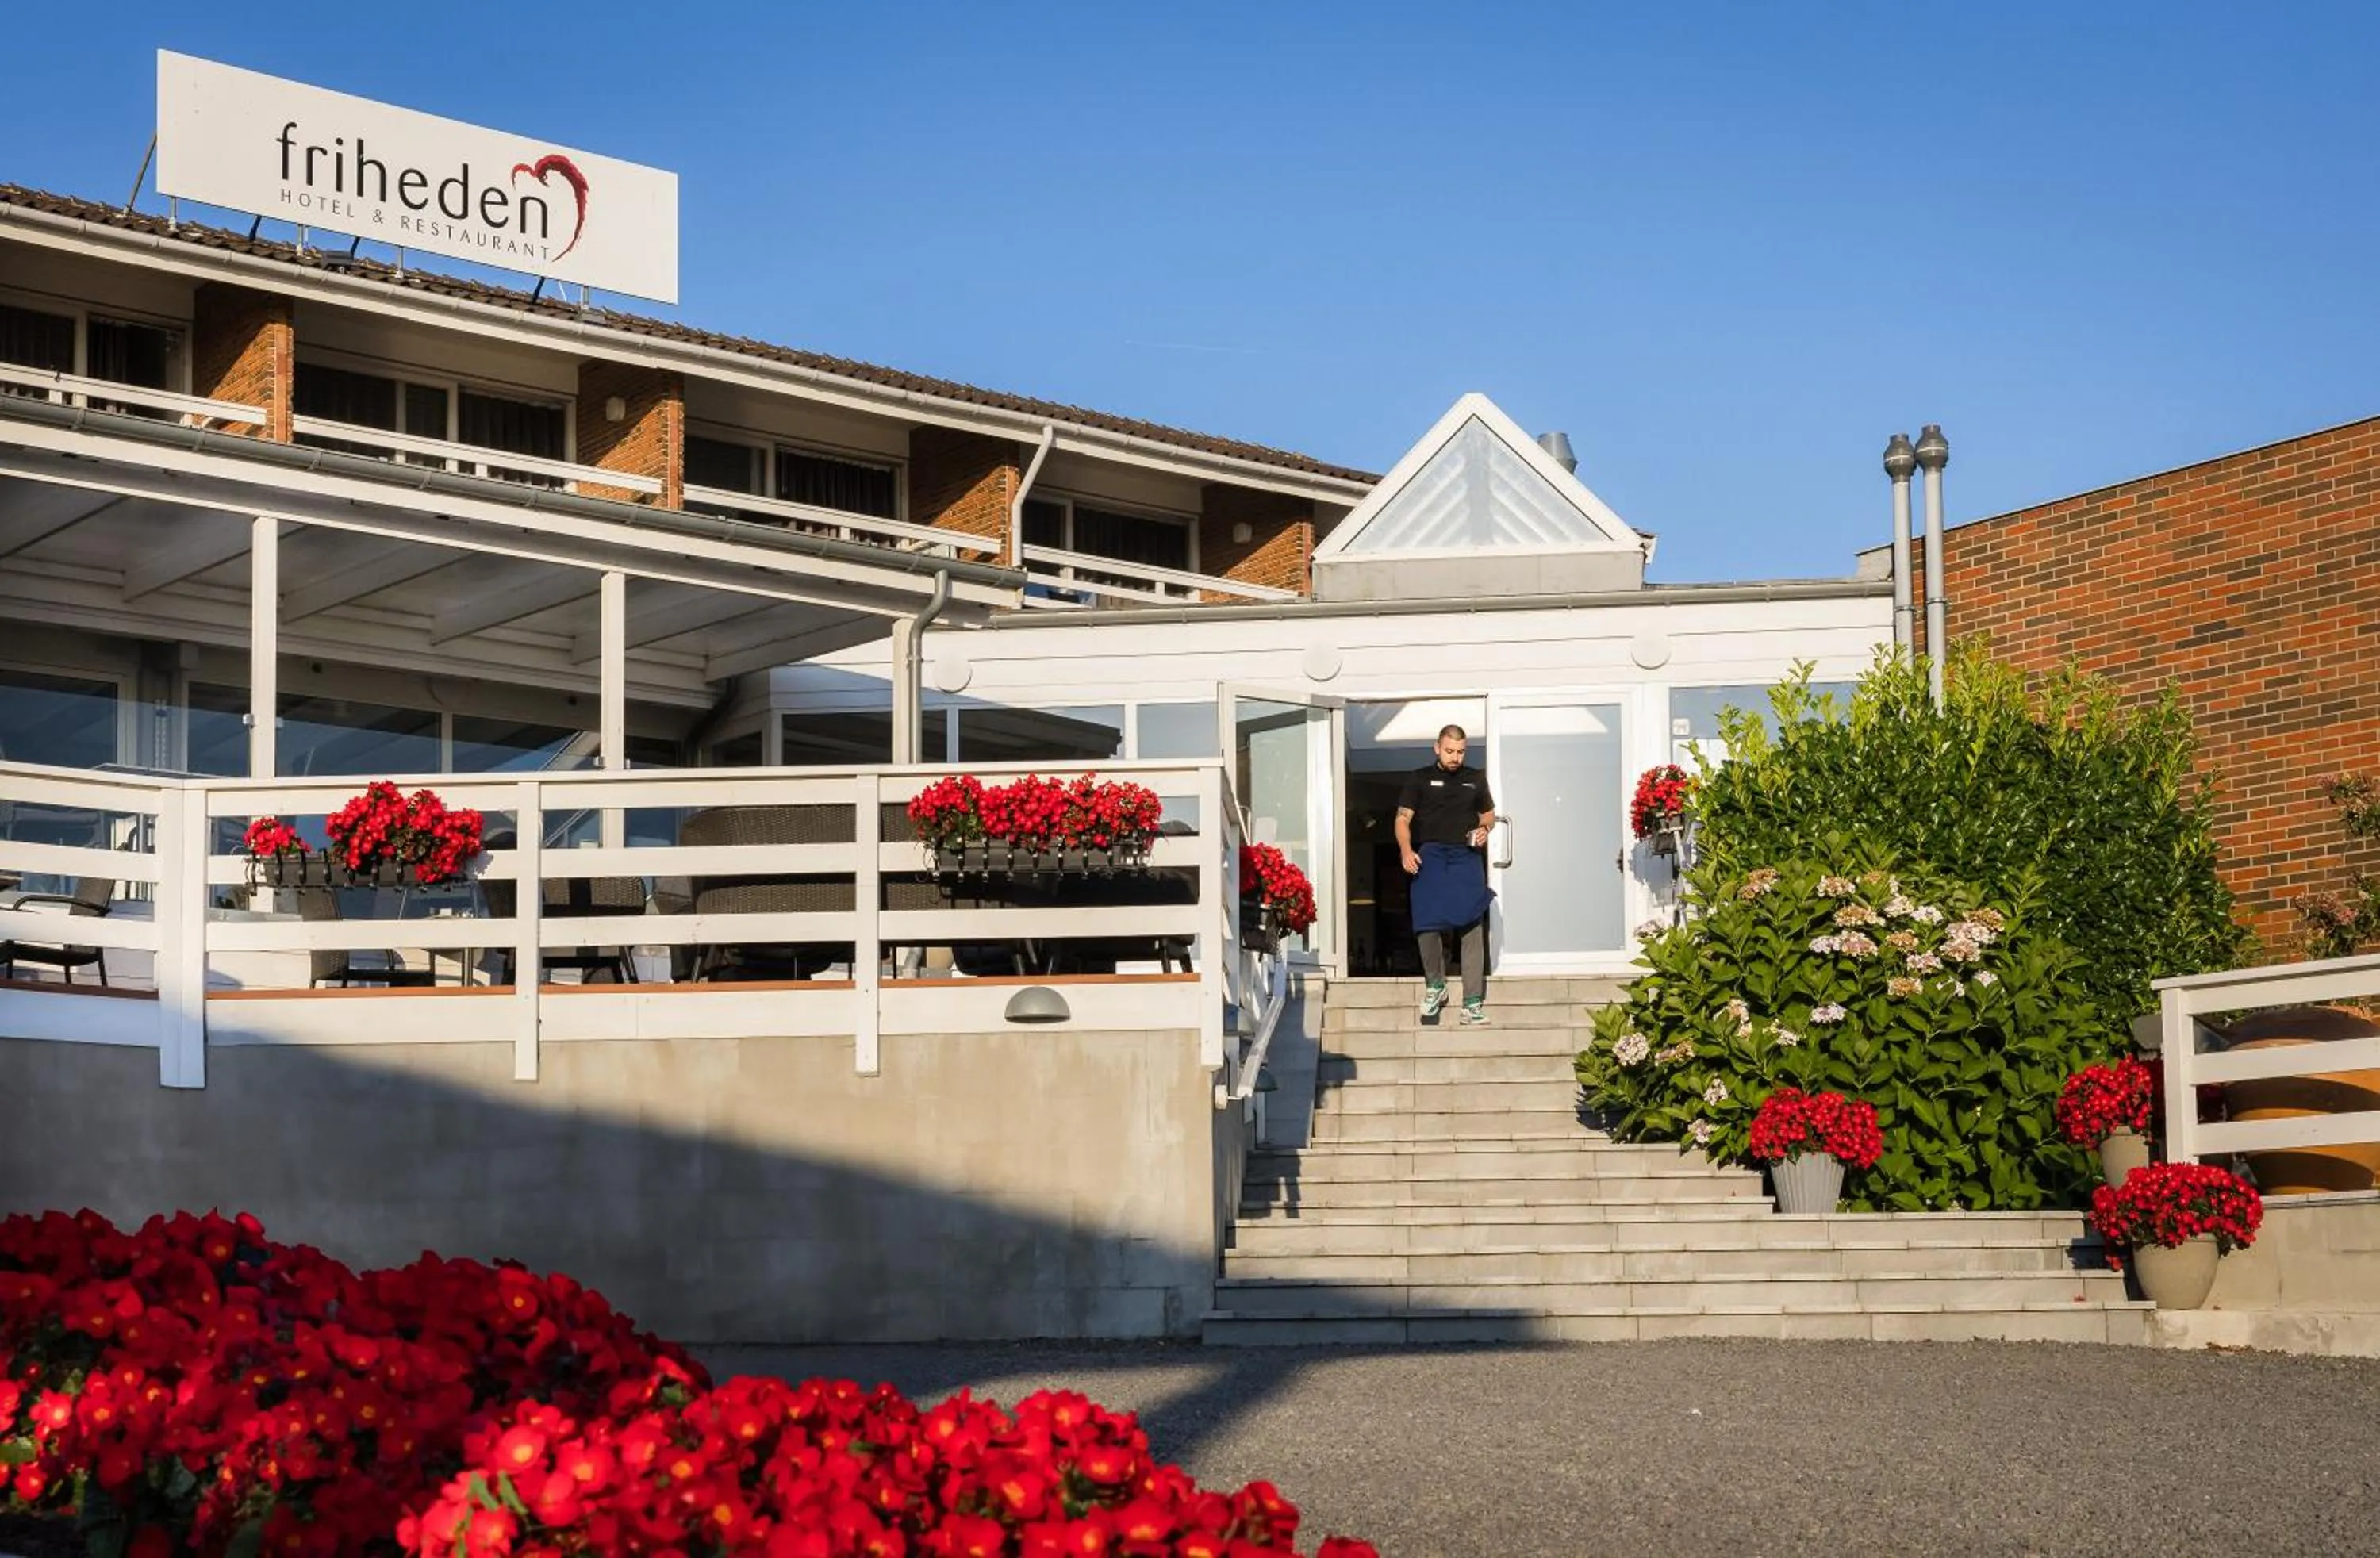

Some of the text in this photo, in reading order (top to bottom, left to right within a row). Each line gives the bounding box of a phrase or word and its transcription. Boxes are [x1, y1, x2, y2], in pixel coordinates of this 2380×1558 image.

[276, 121, 548, 239] friheden
[280, 188, 550, 261] HOTEL & RESTAURANT
